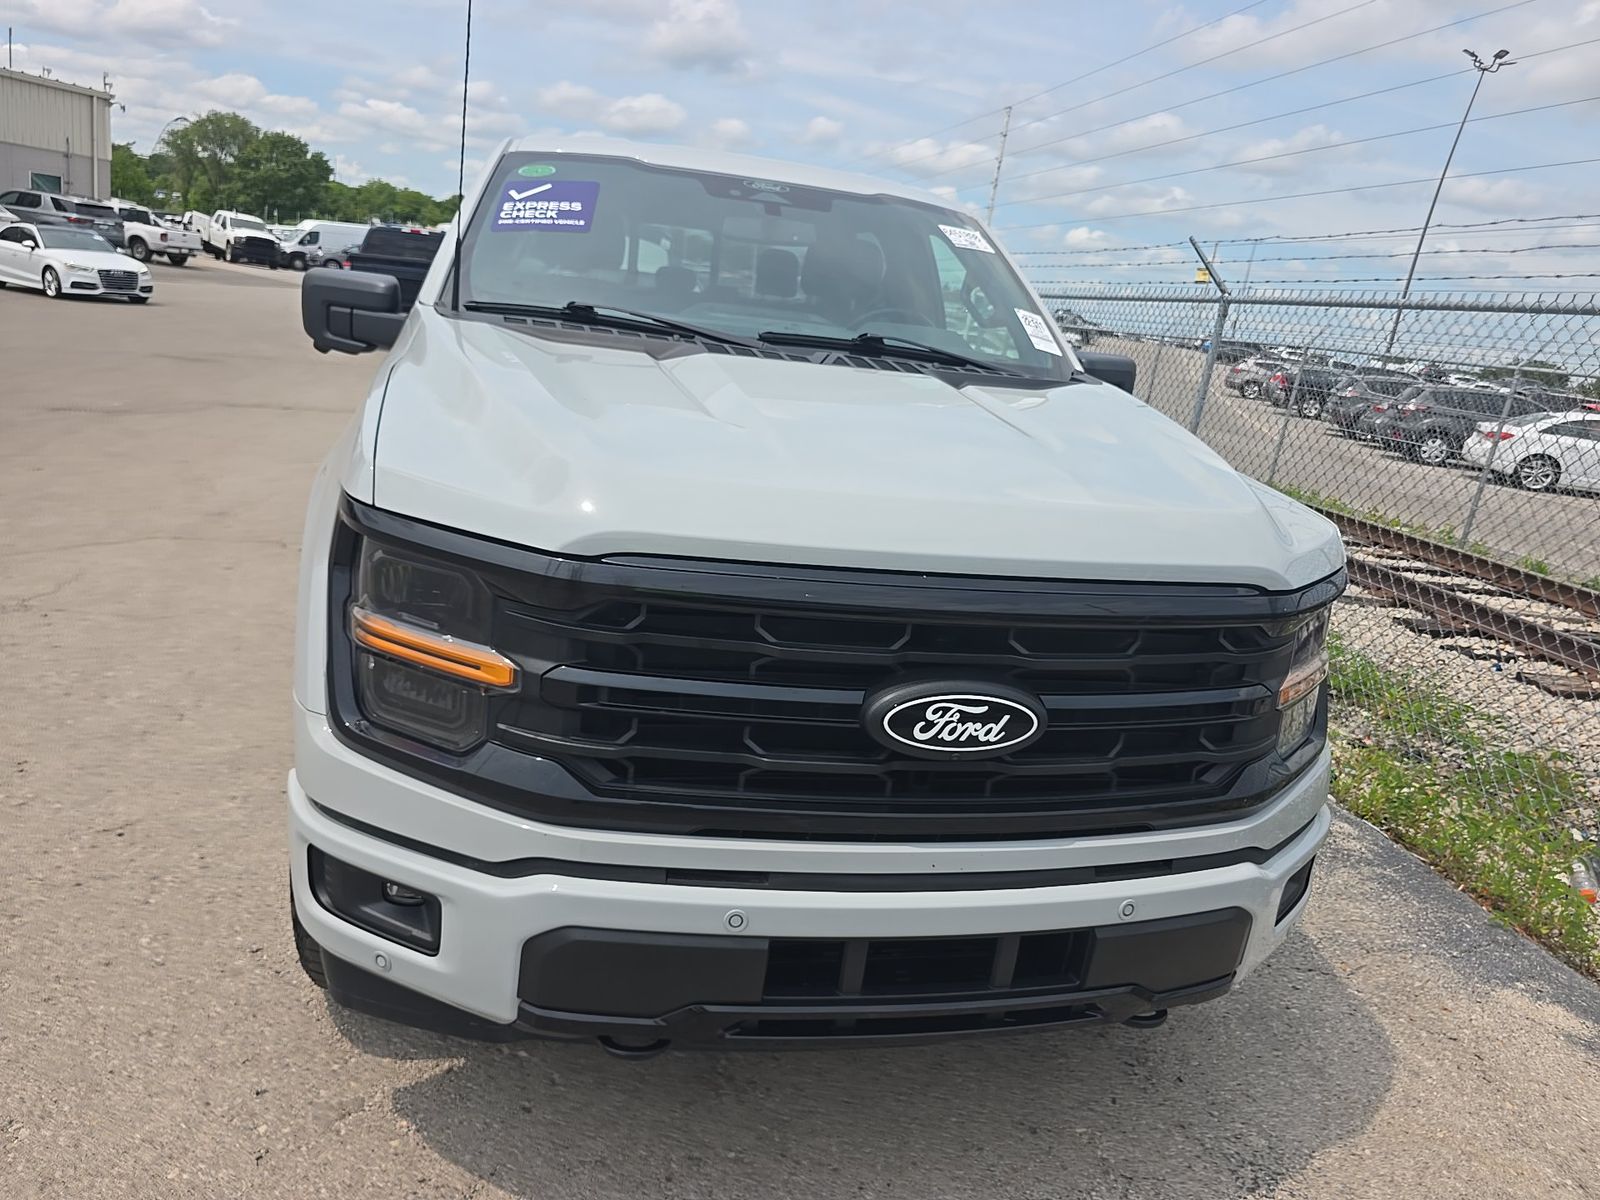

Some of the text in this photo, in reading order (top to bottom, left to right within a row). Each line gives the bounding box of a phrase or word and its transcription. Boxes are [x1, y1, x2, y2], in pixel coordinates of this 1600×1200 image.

[502, 201, 582, 211] EXPRESS
[500, 210, 558, 218] CHECK
[913, 702, 1011, 742] Ford
